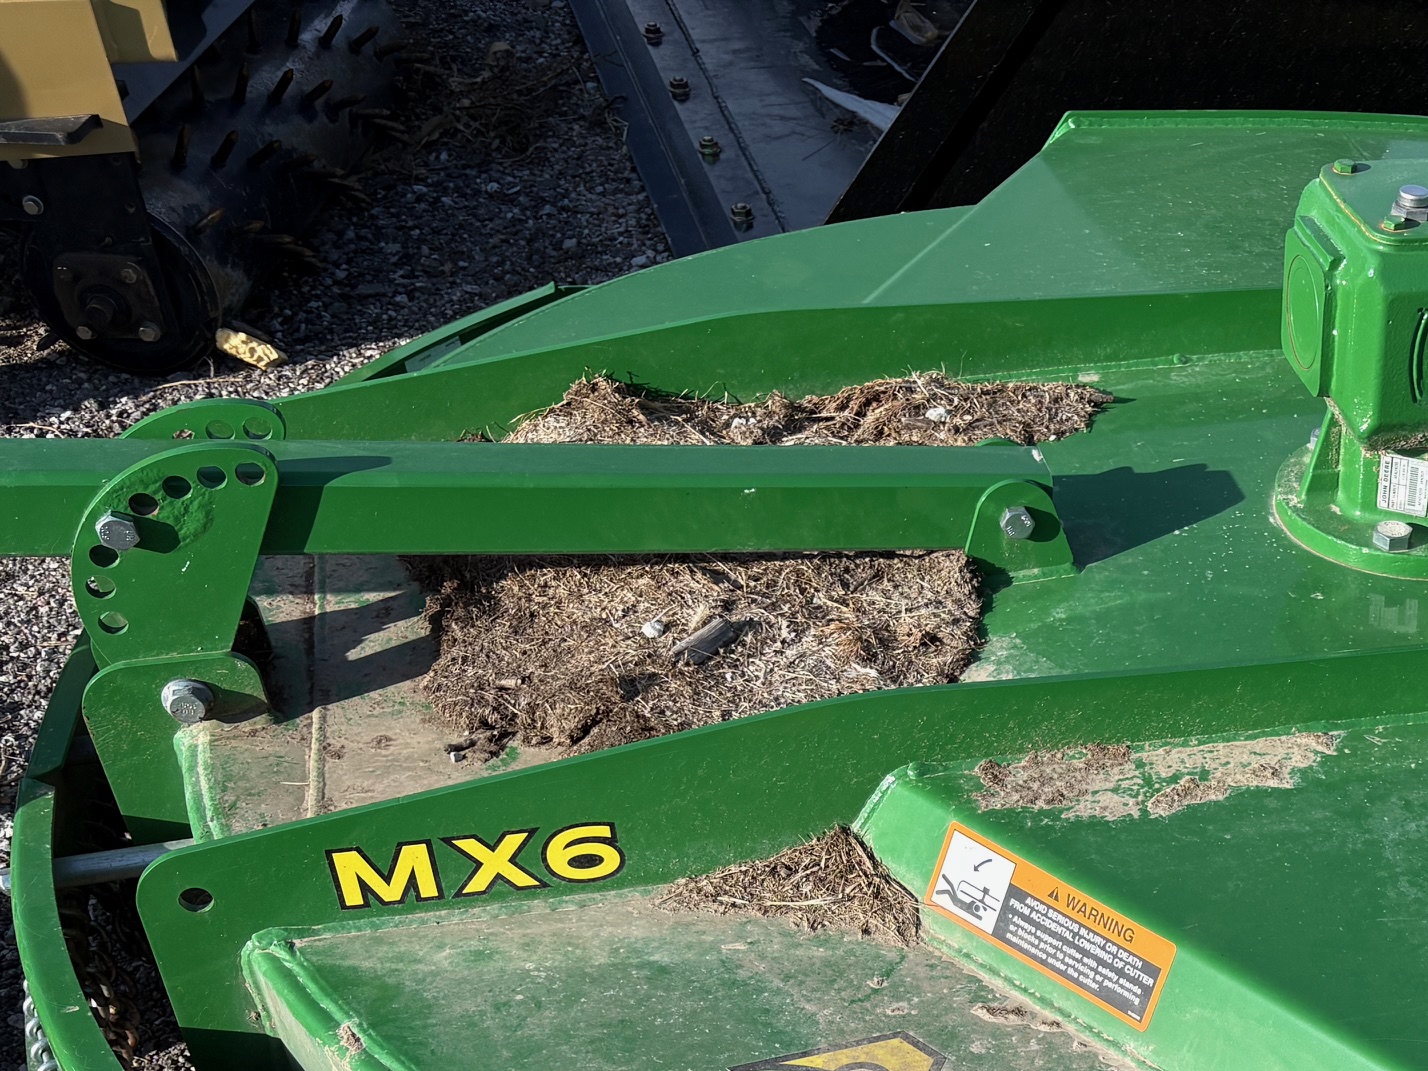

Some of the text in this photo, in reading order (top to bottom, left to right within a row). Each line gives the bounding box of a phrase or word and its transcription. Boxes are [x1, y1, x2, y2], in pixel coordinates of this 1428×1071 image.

[326, 822, 626, 910] MX6
[1005, 932, 1047, 960] maintenance
[1047, 956, 1067, 971] under
[1067, 966, 1079, 979] the
[1009, 898, 1155, 988] FROM ACCIDENTAL LOWERING OF CUTTER
[1012, 915, 1142, 995] Always support cutter with safety stands
[1025, 896, 1143, 969] AVOID SERIOUS INJURY OR DEATH
[1066, 893, 1135, 943] WARNING
[1017, 927, 1039, 945] blocks
[1038, 941, 1057, 955] prior
[1056, 950, 1064, 960] to
[1064, 956, 1096, 979] servicing
[1095, 973, 1104, 983] or
[1103, 978, 1141, 1006] performing
